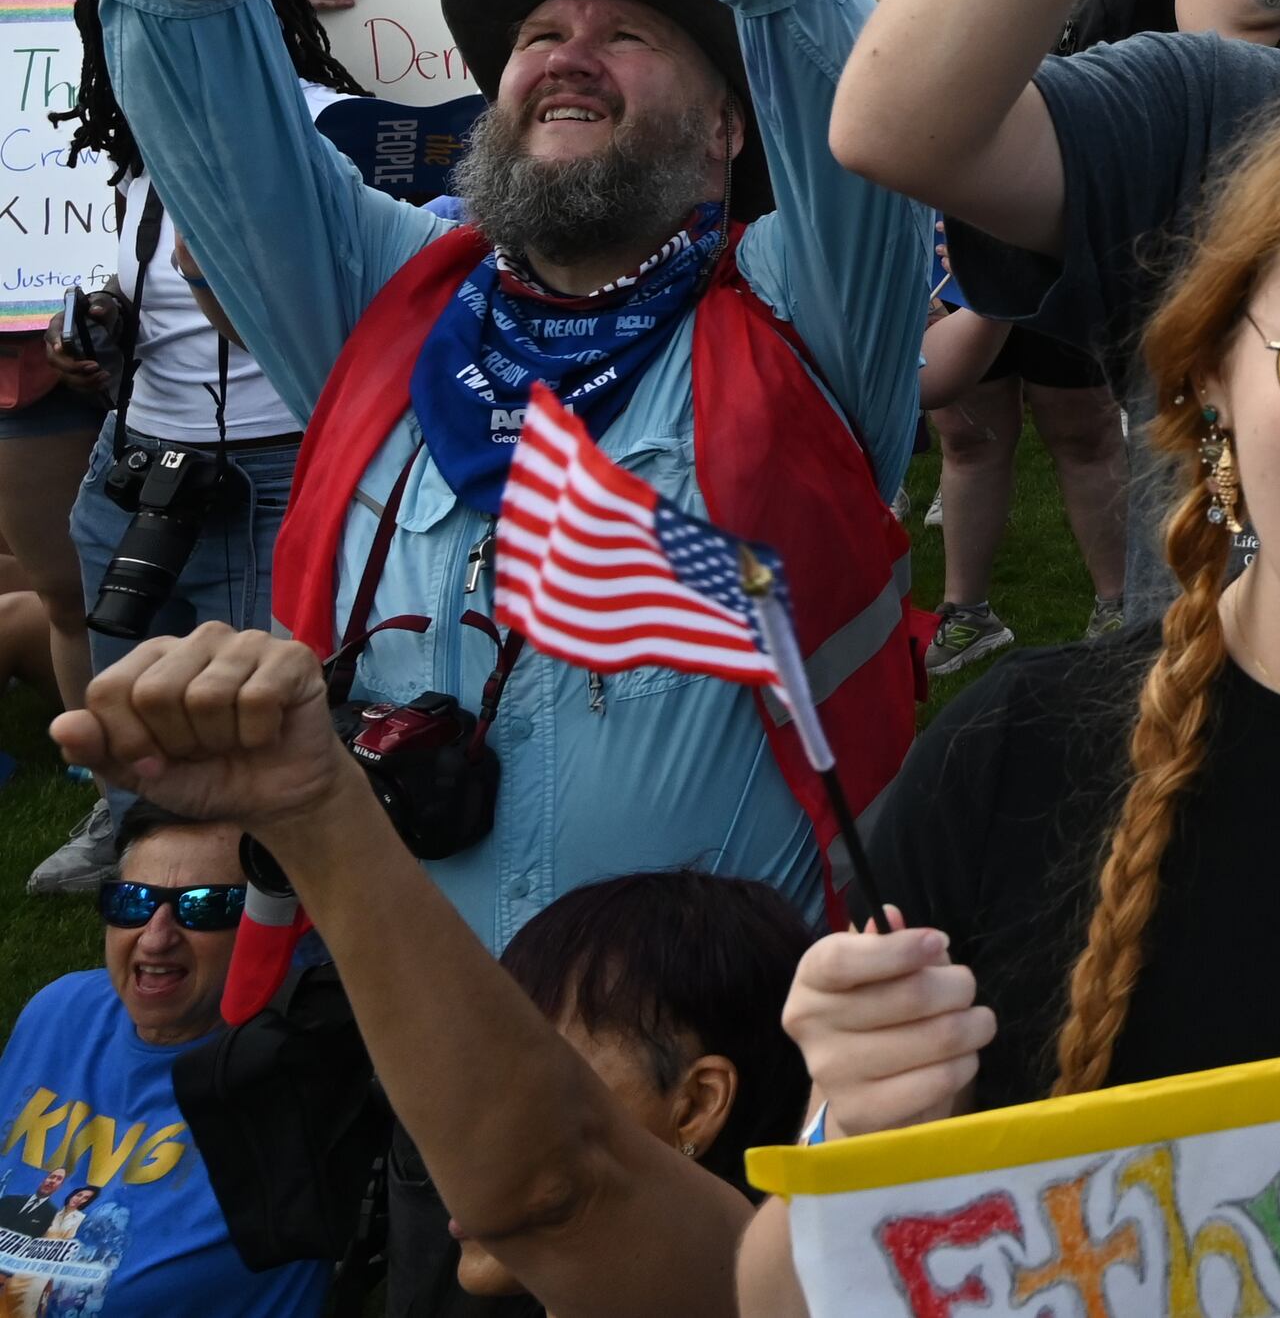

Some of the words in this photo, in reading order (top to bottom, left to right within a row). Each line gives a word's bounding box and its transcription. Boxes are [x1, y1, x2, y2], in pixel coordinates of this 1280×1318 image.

[374, 119, 418, 186] PEOPLE
[4, 268, 81, 290] Justice
[544, 316, 599, 338] READY
[615, 315, 656, 331] ACLU
[482, 349, 529, 388] READY
[492, 433, 522, 444] Geor
[353, 744, 382, 761] Nikon
